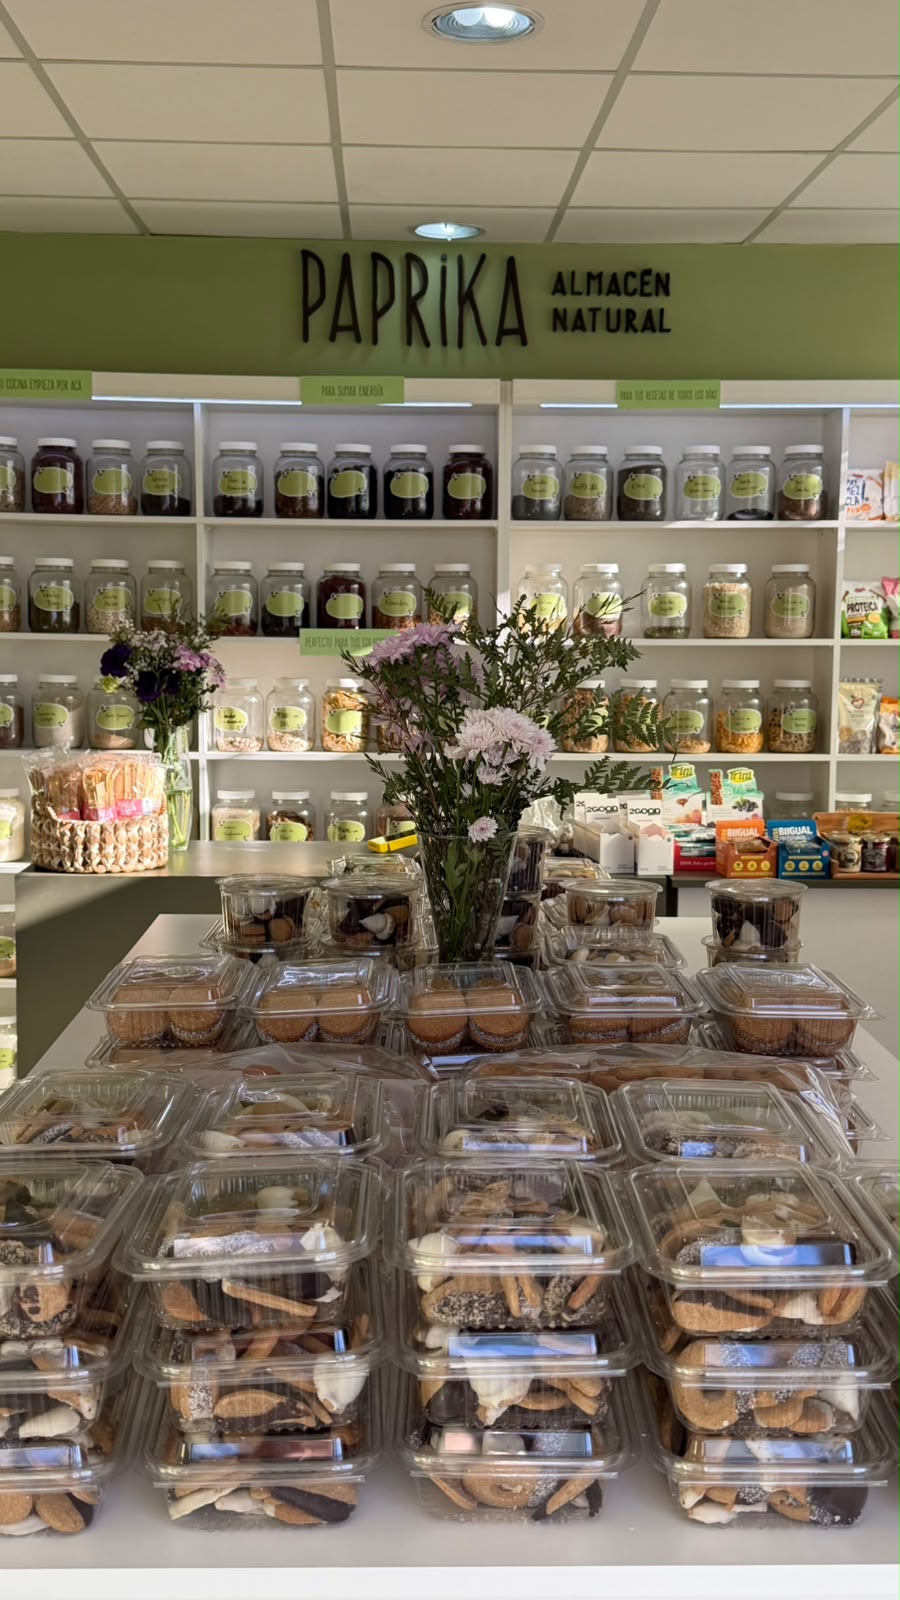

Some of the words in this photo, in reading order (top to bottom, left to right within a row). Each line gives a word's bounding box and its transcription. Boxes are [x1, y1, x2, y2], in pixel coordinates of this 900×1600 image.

[551, 268, 671, 297] ALMACÉN
[551, 307, 672, 334] NATURAL
[6, 378, 28, 390] COCINA
[29, 379, 55, 391] EMPIEZA
[56, 379, 68, 391] POR
[321, 385, 336, 397] PARA
[337, 385, 356, 397] SUMAR
[620, 390, 633, 400] PARA
[646, 390, 666, 400] RECETAS
[668, 390, 675, 400] DE
[305, 637, 333, 648] PERFECTO
[334, 637, 348, 648] PARA
